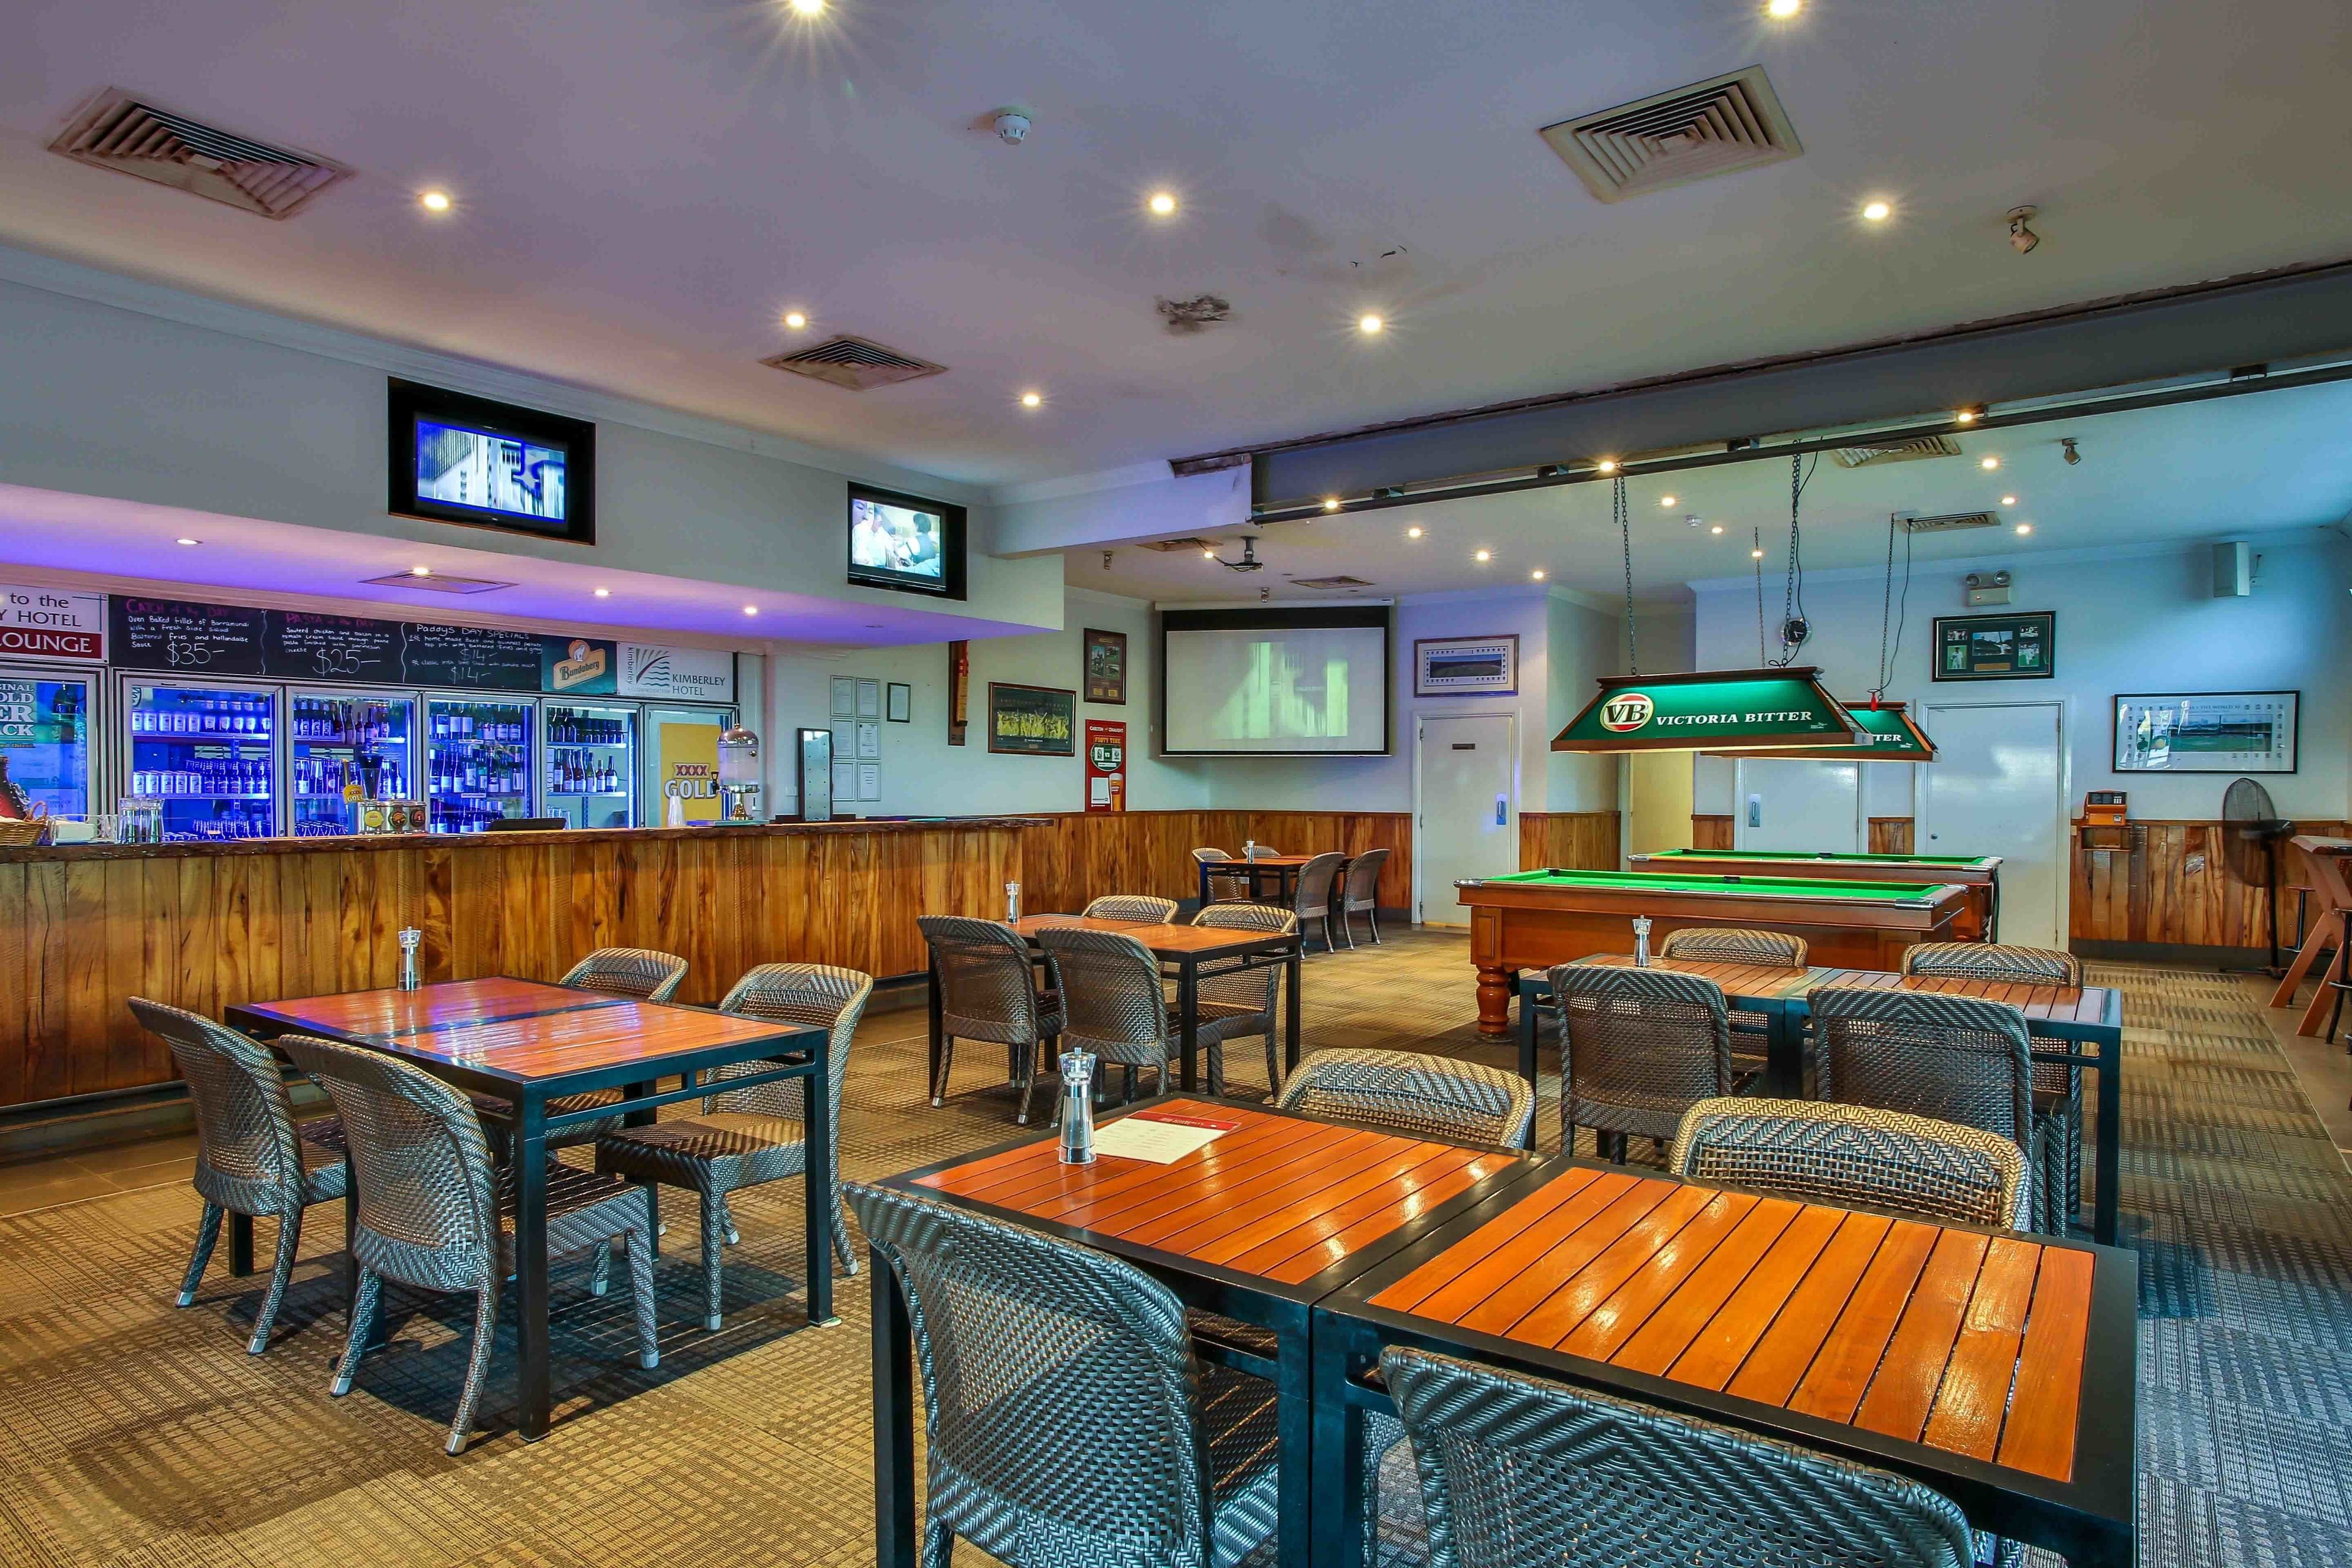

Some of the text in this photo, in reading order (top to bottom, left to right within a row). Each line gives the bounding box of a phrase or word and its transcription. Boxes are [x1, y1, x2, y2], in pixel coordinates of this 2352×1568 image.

[10, 592, 69, 609] to the
[18, 610, 82, 627] HOTEL
[461, 628, 483, 637] DAY
[487, 630, 530, 639] SPECIALS
[0, 632, 92, 653] OUNGE
[559, 661, 600, 681] Bundaberg
[673, 674, 726, 686] KIMBERLEY
[673, 686, 705, 696] HOTEL
[1605, 703, 1648, 724] VB
[1656, 711, 1812, 726] VICTORIA BITTER
[676, 764, 707, 776] XXXX
